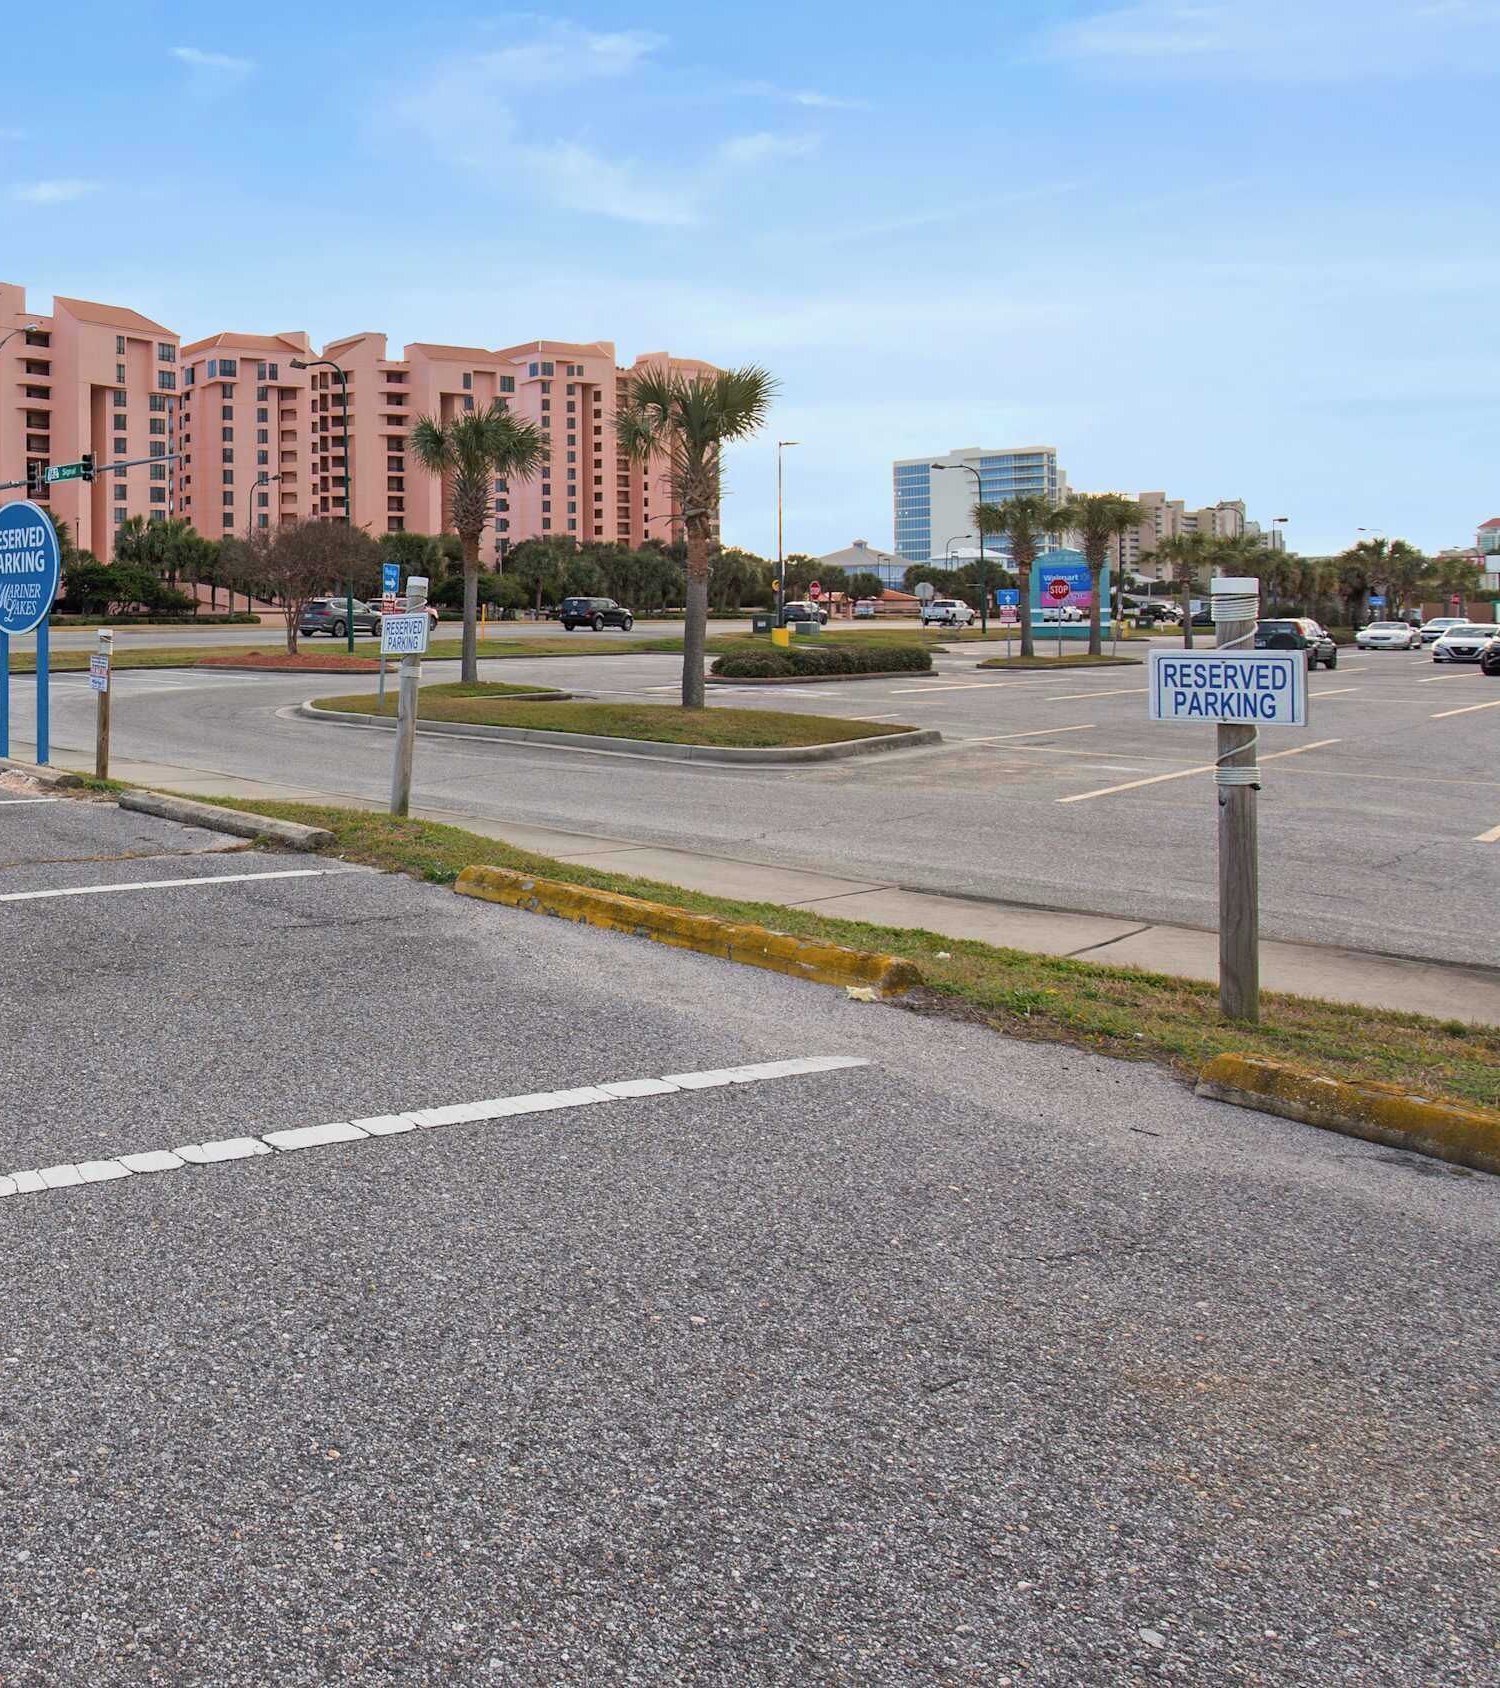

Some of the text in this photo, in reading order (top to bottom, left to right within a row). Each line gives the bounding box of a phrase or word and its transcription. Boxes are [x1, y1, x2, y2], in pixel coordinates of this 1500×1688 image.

[1050, 584, 1068, 595] STOP
[4, 599, 37, 622] LAKES
[386, 620, 423, 636] RESERVED
[387, 635, 418, 650] PARKING
[1163, 663, 1287, 691] RESERVED
[1173, 690, 1276, 719] PARKING
